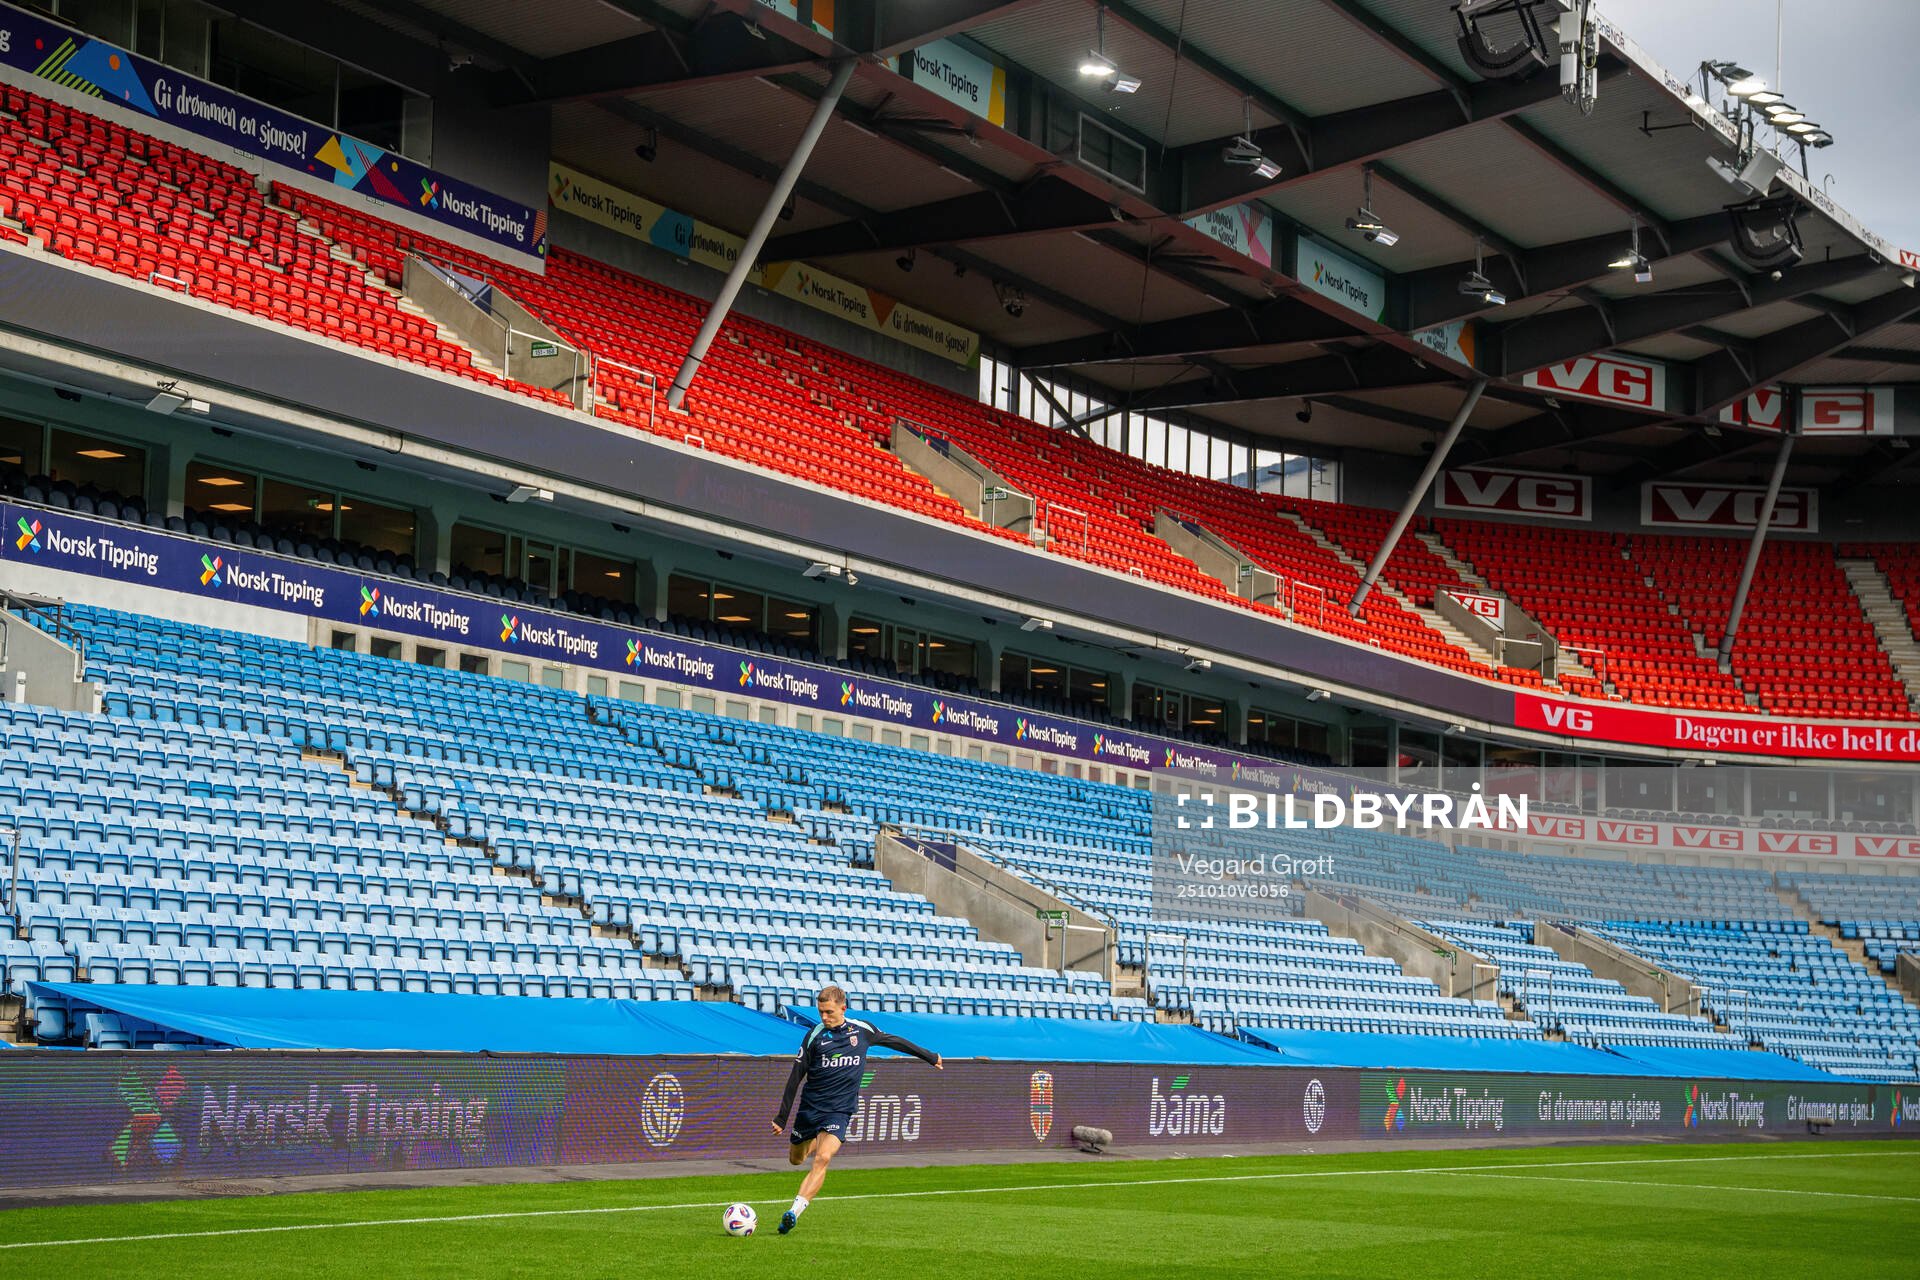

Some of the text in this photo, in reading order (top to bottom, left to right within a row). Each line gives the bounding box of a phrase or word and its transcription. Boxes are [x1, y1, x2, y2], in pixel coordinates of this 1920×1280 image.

[914, 49, 979, 102] Norsk Tipping
[154, 78, 307, 159] Gi drømmen en sjanse!
[442, 190, 525, 242] Norsk Tipping
[573, 185, 642, 230] Norsk Tipping
[675, 222, 686, 245] Gi
[727, 245, 737, 262] en
[811, 281, 866, 318] Norsk Tipping
[1325, 270, 1368, 307] Norsk Tipping
[1548, 357, 1648, 402] VG
[1450, 471, 1576, 514] VG
[1657, 487, 1800, 526] VG
[48, 528, 159, 576] Norsk Tipping
[227, 563, 324, 608] Norsk Tipping
[383, 595, 470, 635] Norsk Tipping
[521, 622, 599, 659] Norsk Tipping
[645, 646, 715, 681] Norsk Tipping
[755, 668, 819, 701] Norsk Tipping
[855, 688, 913, 719] Norsk Tipping
[946, 706, 999, 735] Norsk Tipping
[1541, 704, 1593, 731] VG
[1028, 723, 1077, 751] Norsk Tipping
[1105, 739, 1150, 764] Norsk Tipping
[1675, 717, 1748, 748] Dagen
[1752, 726, 1778, 747] er
[1782, 725, 1837, 750] ikke
[1842, 727, 1894, 753] helt
[1176, 753, 1217, 777] Norsk Tipping
[1241, 767, 1280, 788] Norsk Tipping
[1529, 816, 1582, 838] VG
[1599, 823, 1654, 844] VG
[1675, 828, 1739, 848] VG
[1761, 833, 1832, 853] VG
[821, 1054, 860, 1068] bama
[200, 1083, 487, 1155] Norsk Tipping
[846, 1094, 921, 1142] ama
[1149, 1077, 1226, 1136] bama
[1410, 1088, 1504, 1131] Norsk Tipping
[1539, 1091, 1552, 1120] Gi
[1610, 1100, 1624, 1121] en
[1626, 1093, 1661, 1127] sjanse
[1701, 1092, 1764, 1128] Norsk Tipping
[1787, 1095, 1797, 1120] Gi
[1839, 1102, 1849, 1120] en
[1902, 1096, 1920, 1121] Nors
